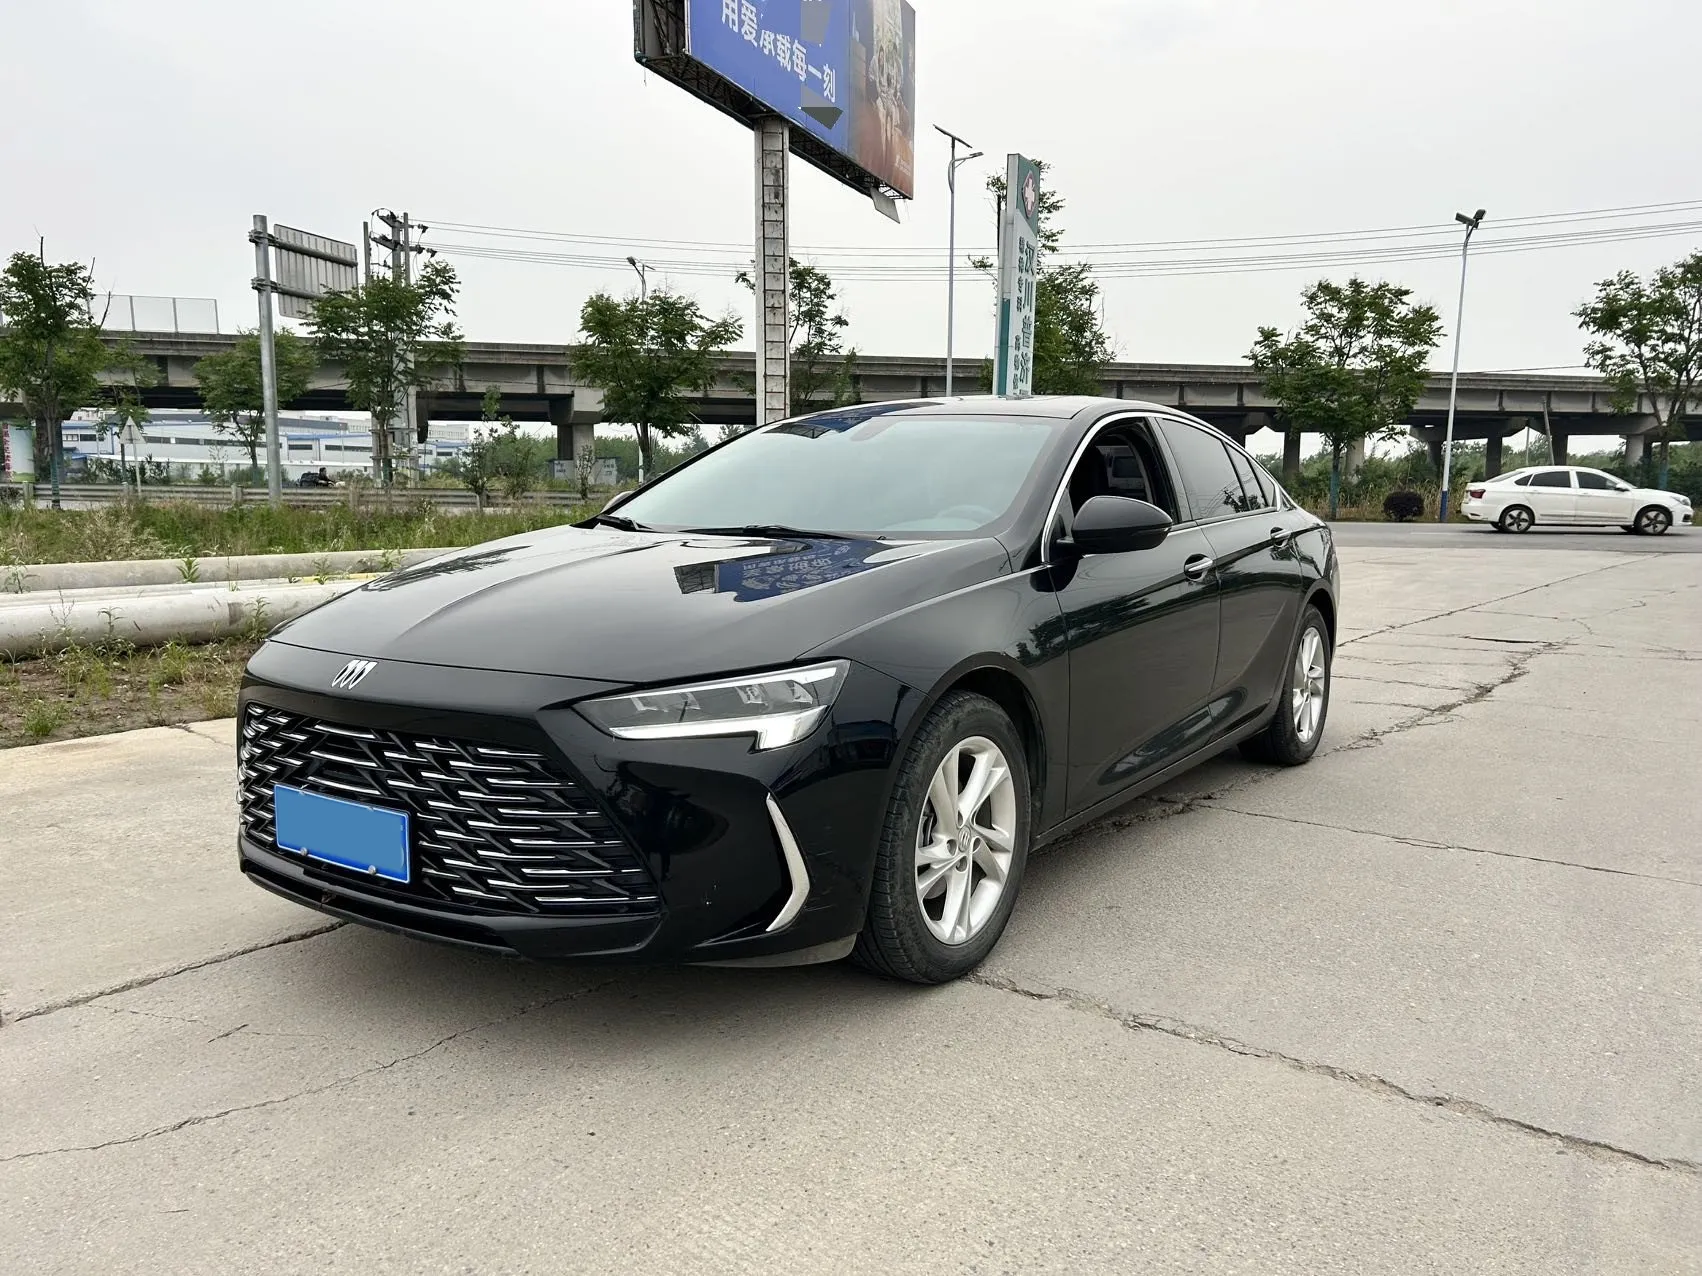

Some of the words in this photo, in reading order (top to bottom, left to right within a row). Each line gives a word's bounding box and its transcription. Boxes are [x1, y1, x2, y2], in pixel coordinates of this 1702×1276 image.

[722, 0, 836, 103] 用爱承载每一刻
[1019, 240, 1035, 395] 汉川普济
